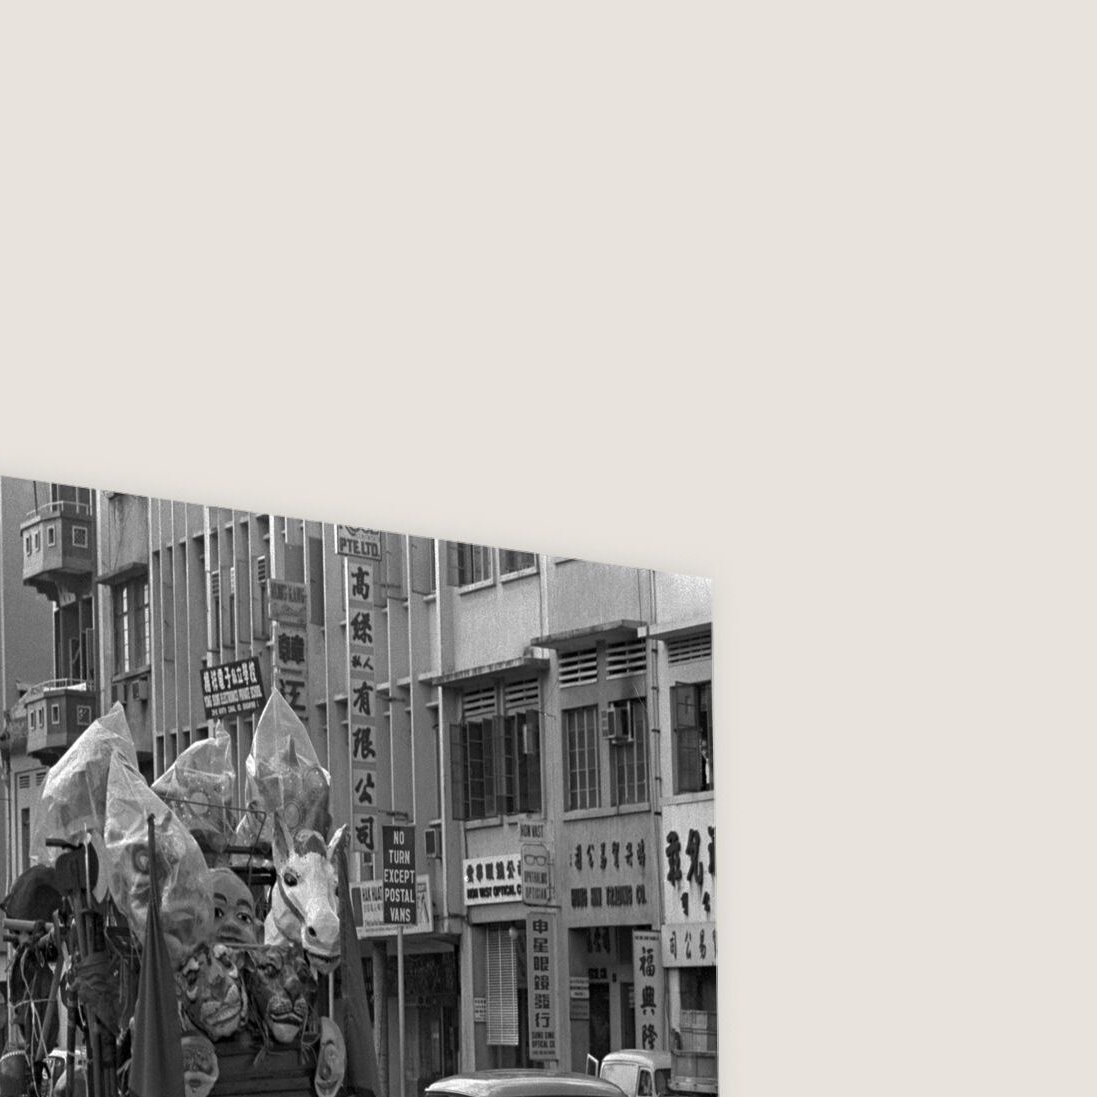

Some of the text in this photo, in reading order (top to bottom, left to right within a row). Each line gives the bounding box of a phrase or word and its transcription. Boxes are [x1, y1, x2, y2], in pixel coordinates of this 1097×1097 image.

[393, 830, 405, 845] NO
[388, 849, 410, 864] TURN
[384, 868, 415, 884] EXCEPT
[384, 888, 415, 903] POSTAL
[390, 907, 411, 922] VANS
